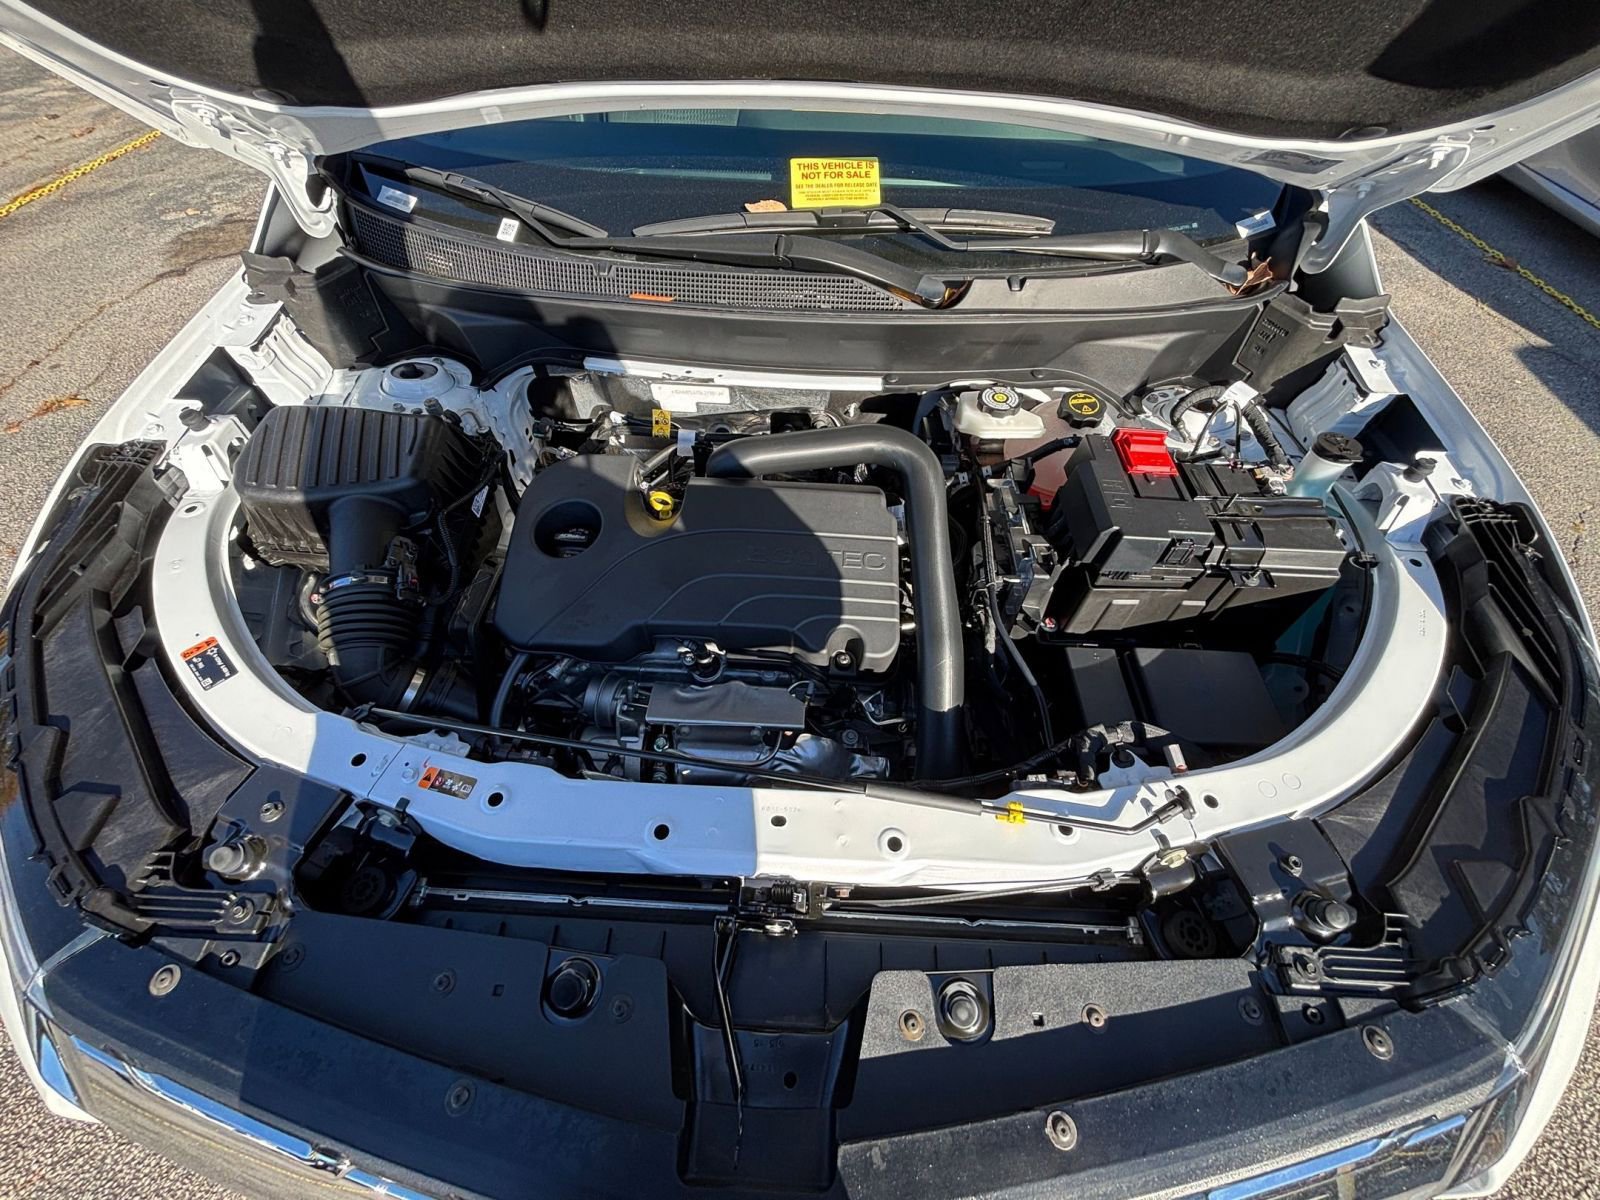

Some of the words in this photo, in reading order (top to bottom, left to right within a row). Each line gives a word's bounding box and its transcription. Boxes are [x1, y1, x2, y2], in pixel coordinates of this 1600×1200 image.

[797, 162, 819, 171] THIS
[821, 161, 863, 170] VEHICLE
[866, 160, 875, 169] IS
[801, 171, 822, 180] NOT
[824, 171, 844, 179] FOR
[846, 170, 871, 179] SALE
